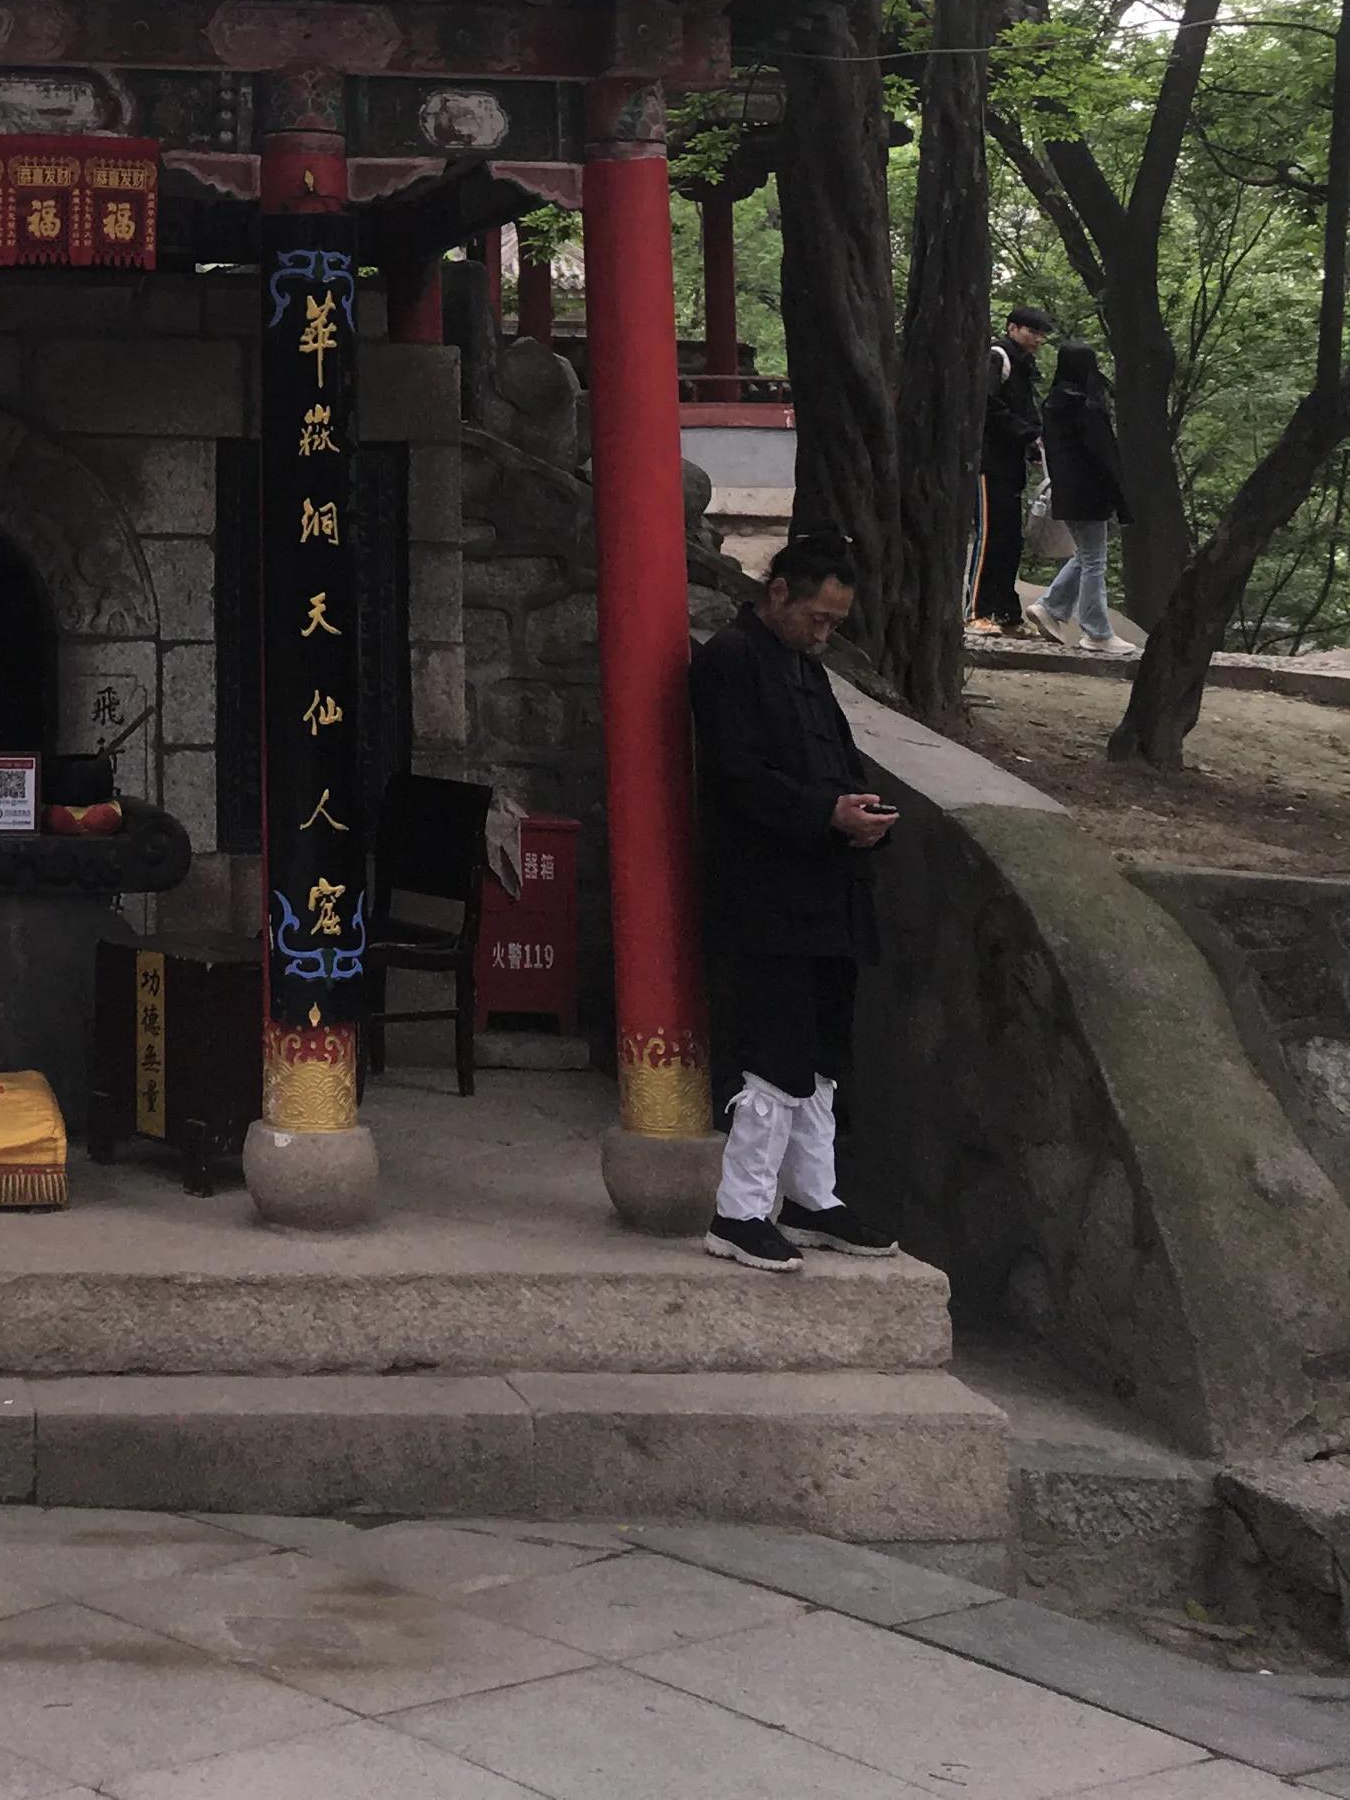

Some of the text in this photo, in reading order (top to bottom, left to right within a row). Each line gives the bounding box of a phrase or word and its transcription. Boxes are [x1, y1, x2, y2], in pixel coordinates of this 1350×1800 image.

[19, 167, 71, 185] 恭喜发财
[95, 169, 146, 188] 恭喜发财
[26, 199, 61, 239] 福
[102, 201, 137, 242] 福
[491, 940, 555, 970] 火警119
